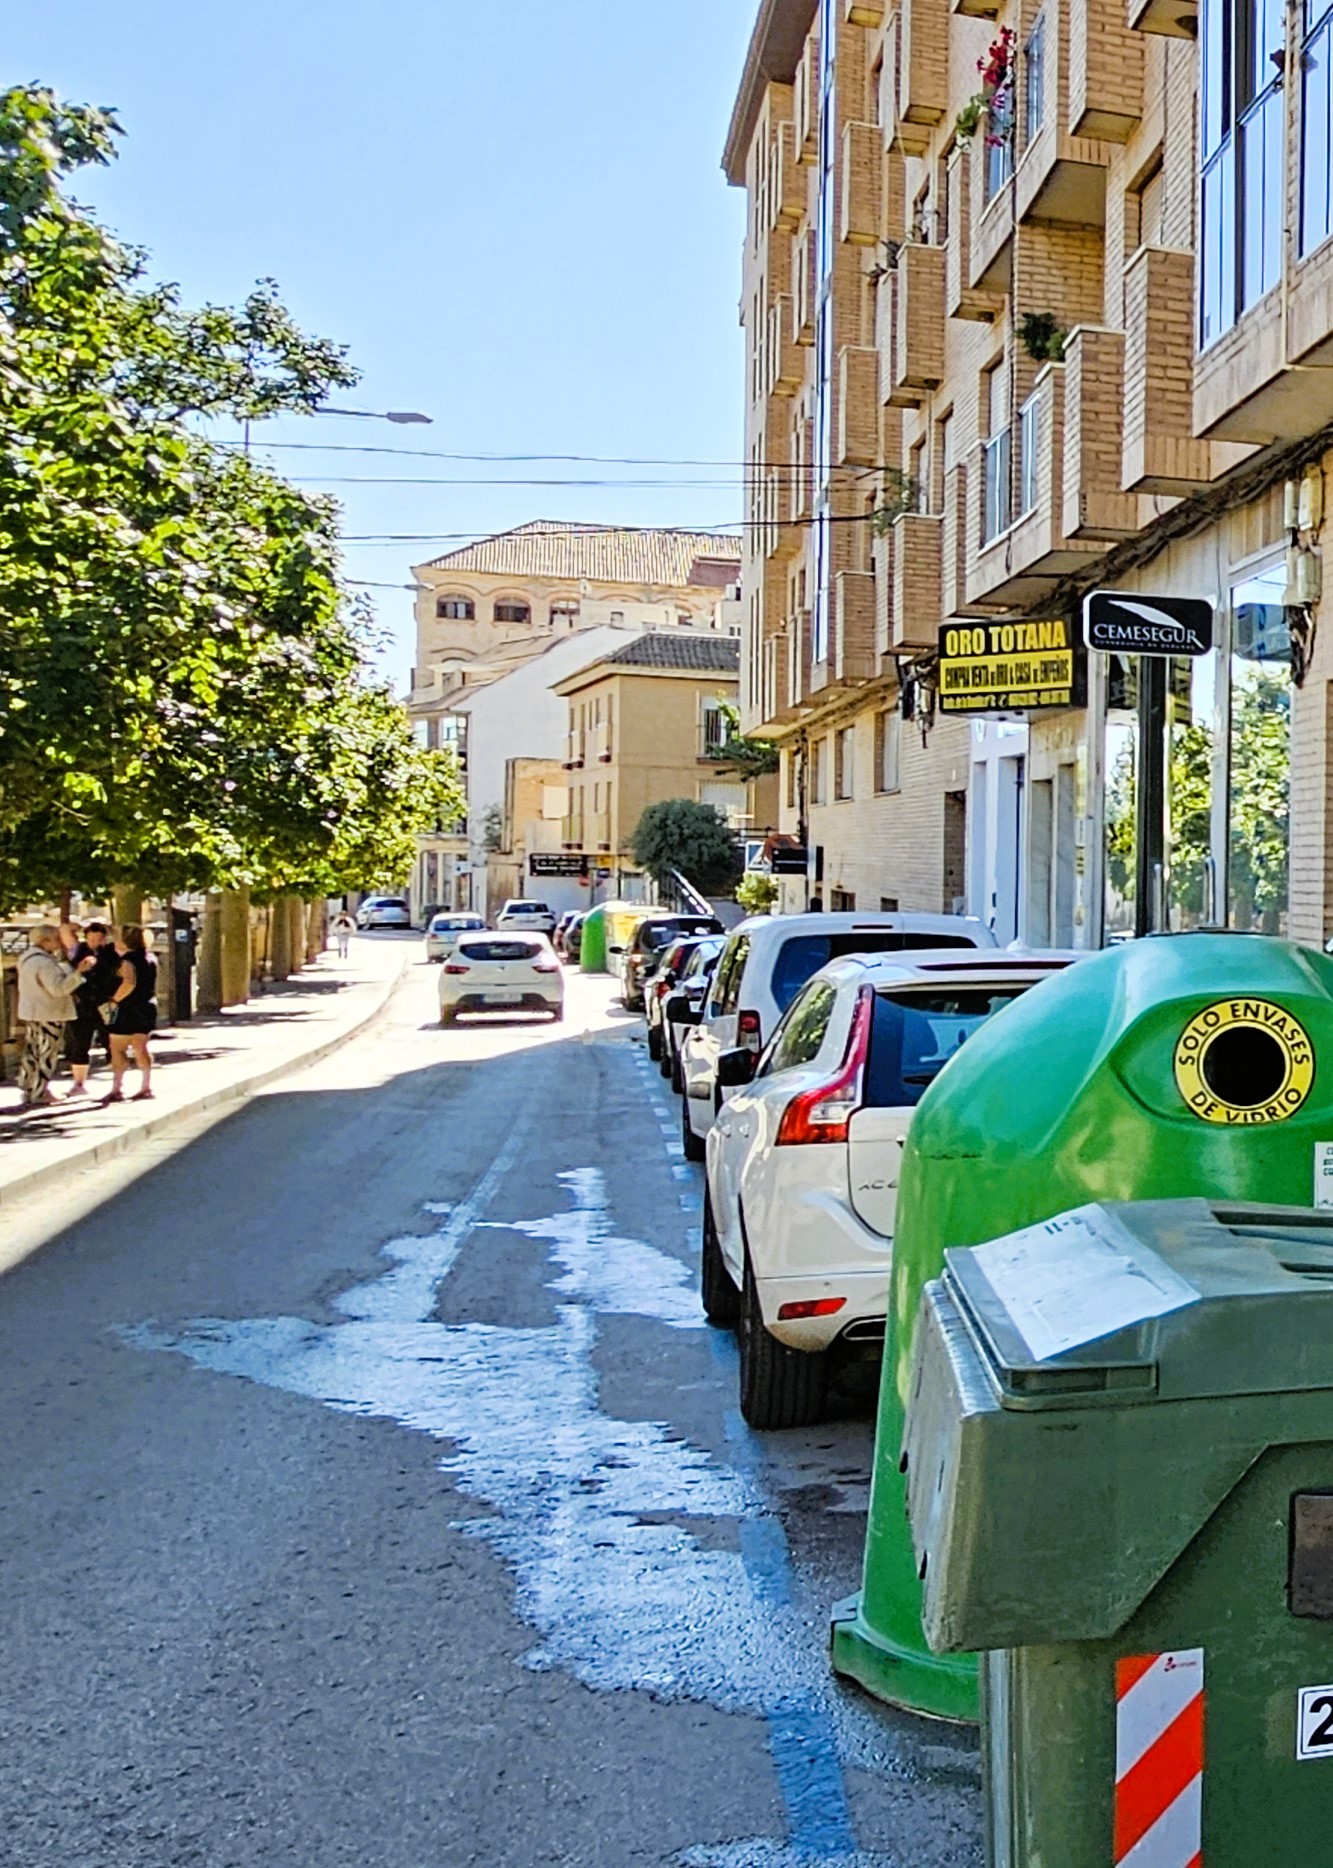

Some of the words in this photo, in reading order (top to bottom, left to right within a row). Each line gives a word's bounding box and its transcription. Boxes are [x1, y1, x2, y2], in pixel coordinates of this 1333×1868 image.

[946, 627, 985, 656] ORO
[988, 621, 1066, 653] TOTANA
[1093, 623, 1205, 650] CEMESEGUR
[1178, 1010, 1221, 1066] SOLO
[1230, 1001, 1310, 1066] ENVASES
[1190, 1090, 1219, 1118] DE
[1225, 1088, 1301, 1122] VIDRIO
